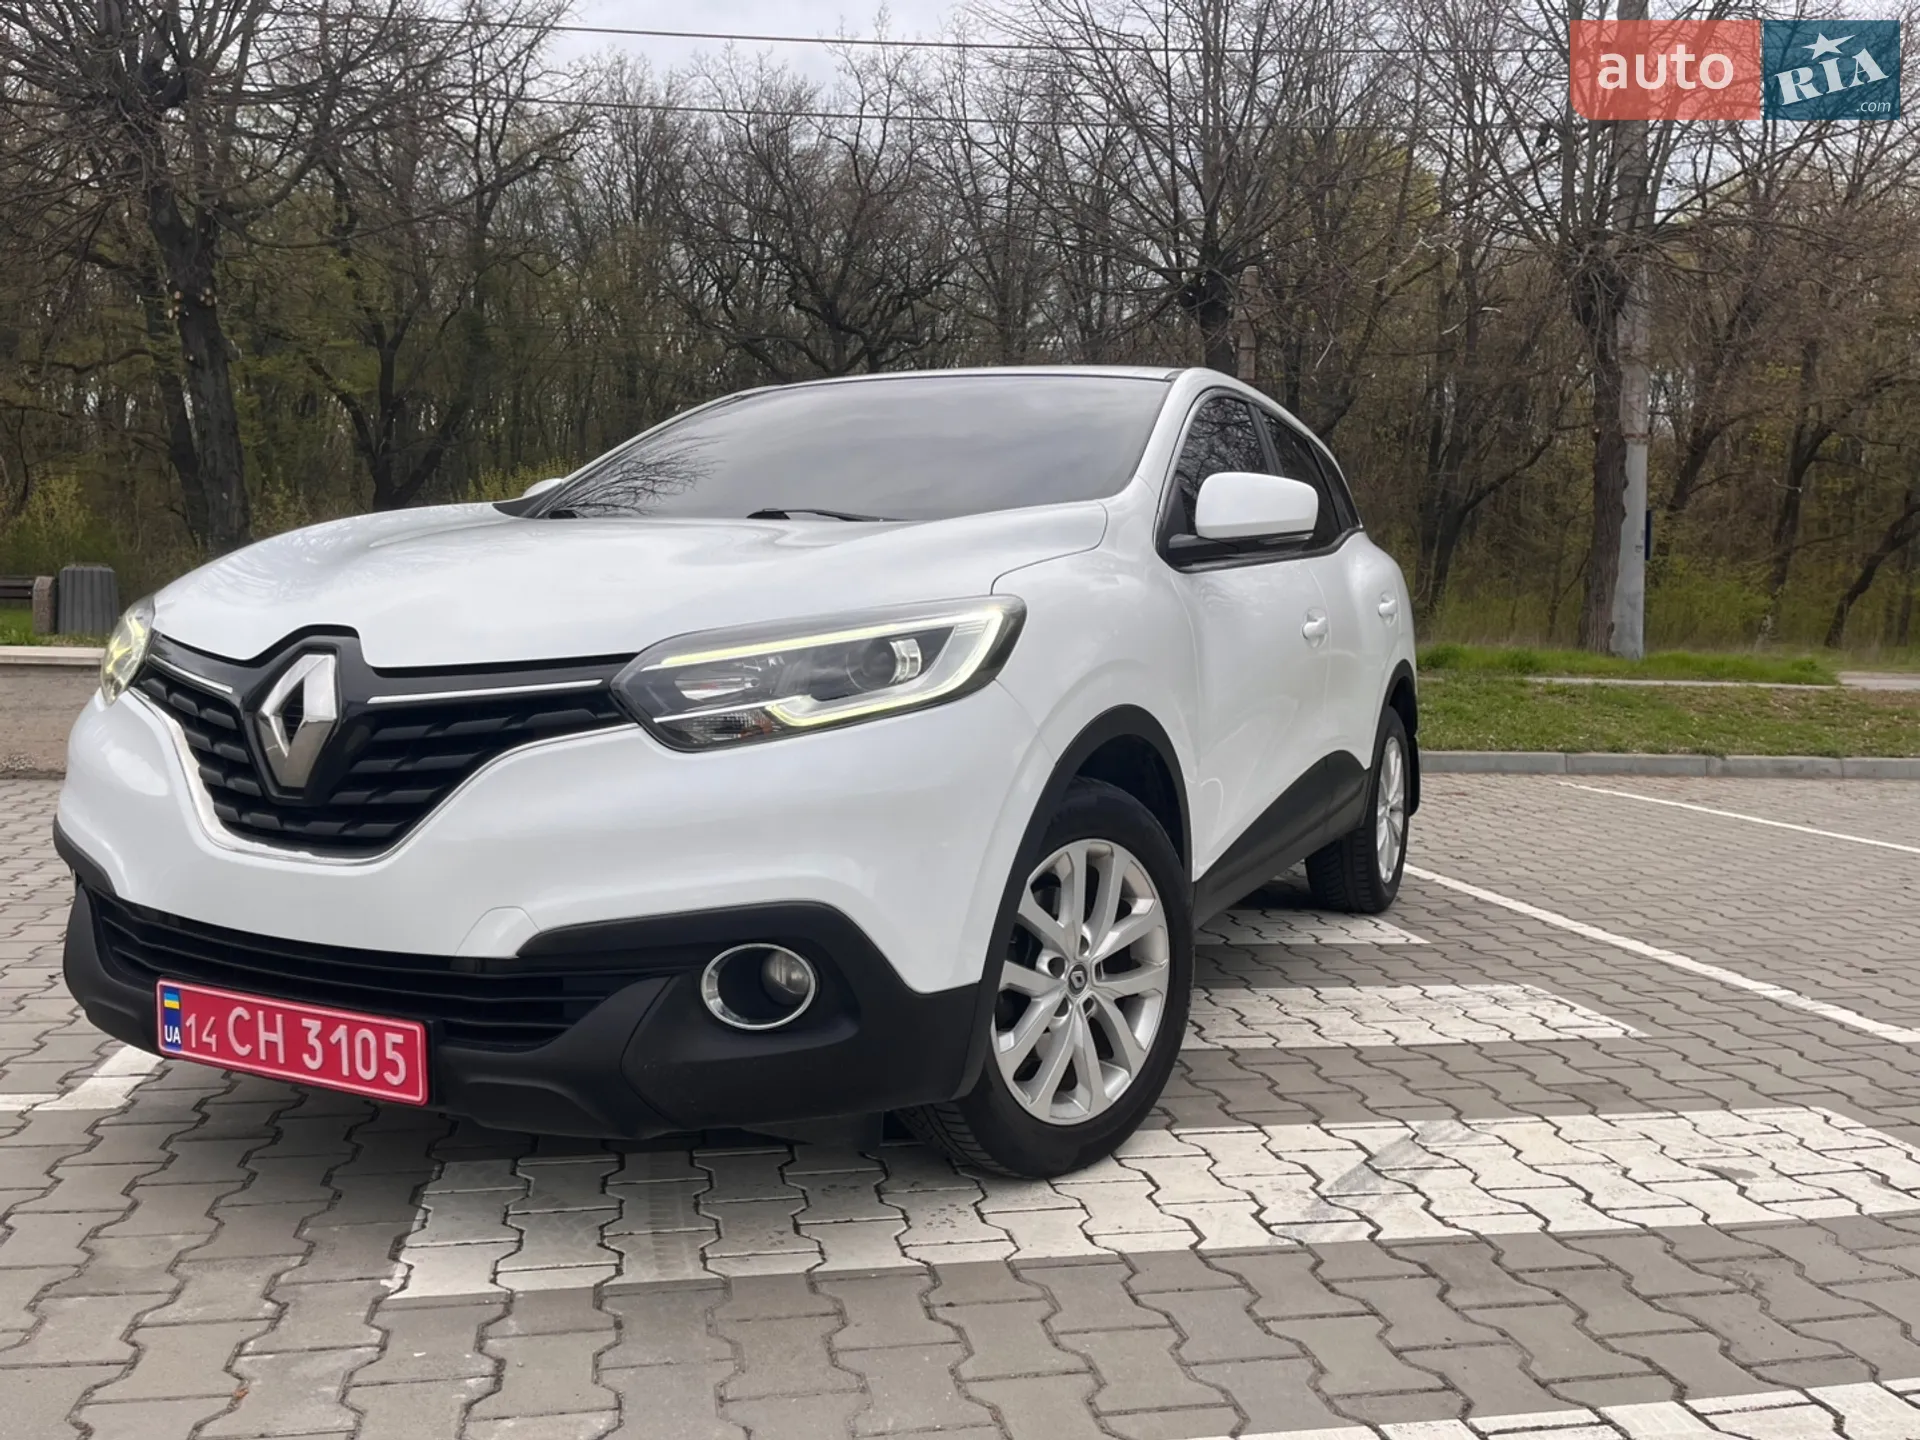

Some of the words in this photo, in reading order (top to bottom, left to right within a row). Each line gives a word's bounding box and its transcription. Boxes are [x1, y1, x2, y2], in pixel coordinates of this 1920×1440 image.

[164, 1024, 182, 1045] UA
[185, 1012, 218, 1052] 14
[227, 1006, 285, 1064] CH
[301, 1018, 407, 1086] 3105
